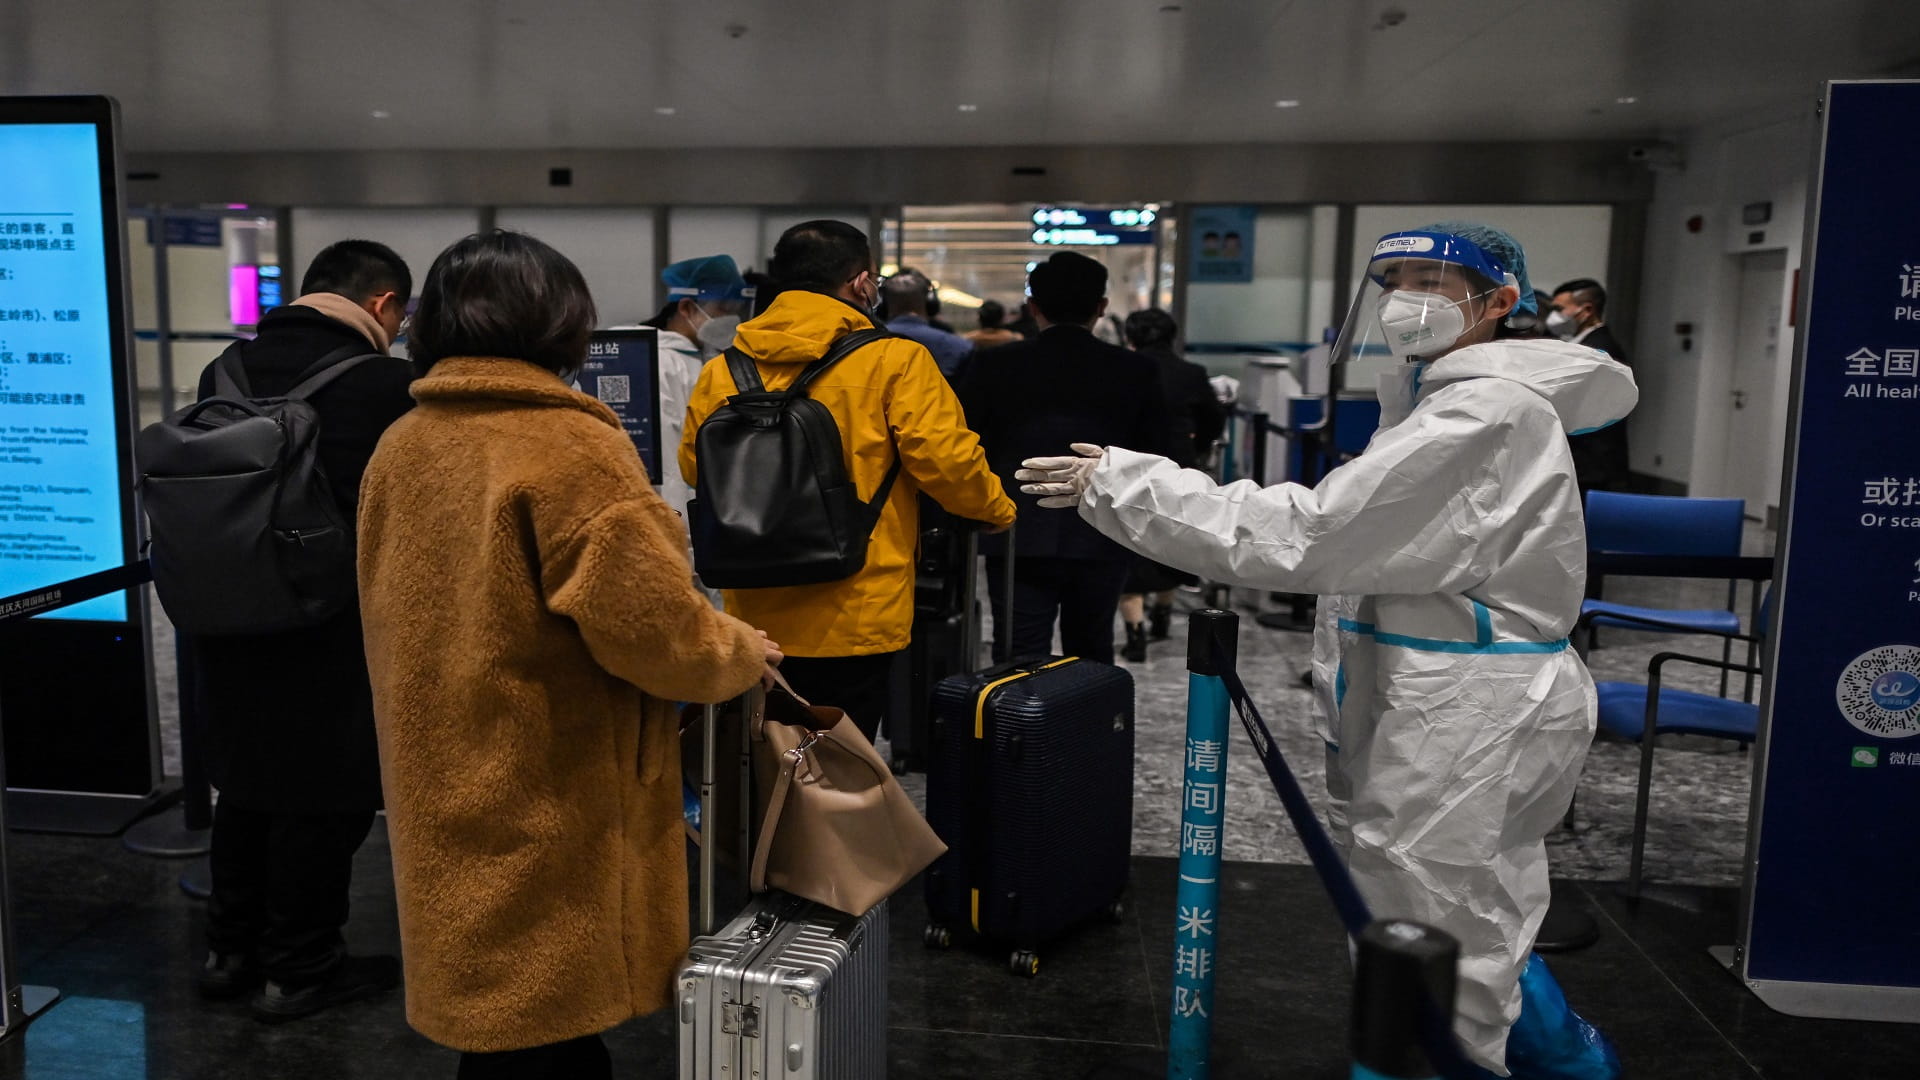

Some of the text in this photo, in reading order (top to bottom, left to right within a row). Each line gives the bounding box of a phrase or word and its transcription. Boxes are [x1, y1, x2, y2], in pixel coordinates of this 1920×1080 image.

[589, 341, 619, 355] 出站
[1844, 346, 1920, 378] 全国
[1843, 383, 1920, 399] All heal
[22, 436, 57, 444] different
[1860, 512, 1920, 529] Or sca
[1889, 750, 1920, 766] 微信
[1174, 738, 1222, 1019] 请间隔一米排队
